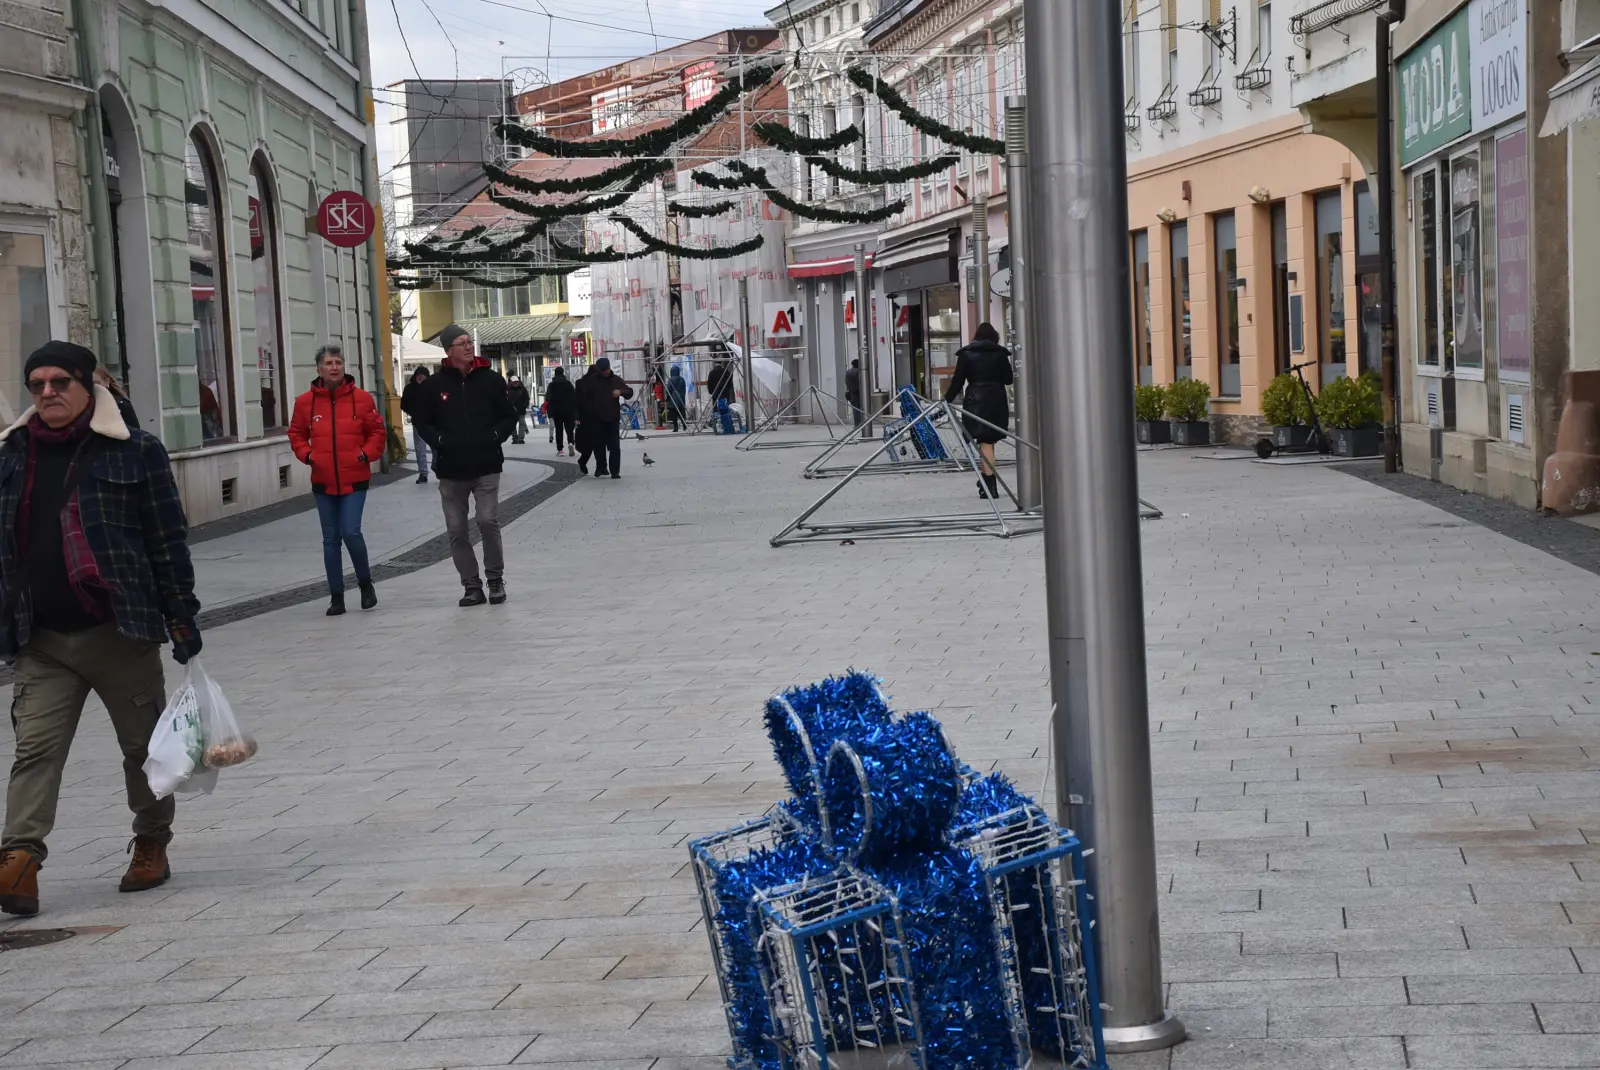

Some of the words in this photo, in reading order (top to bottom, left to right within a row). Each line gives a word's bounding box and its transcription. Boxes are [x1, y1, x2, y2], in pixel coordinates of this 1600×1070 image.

[1403, 31, 1463, 146] MODA
[1481, 45, 1520, 117] LOGOS
[772, 306, 795, 333] A1
[573, 341, 584, 354] T
